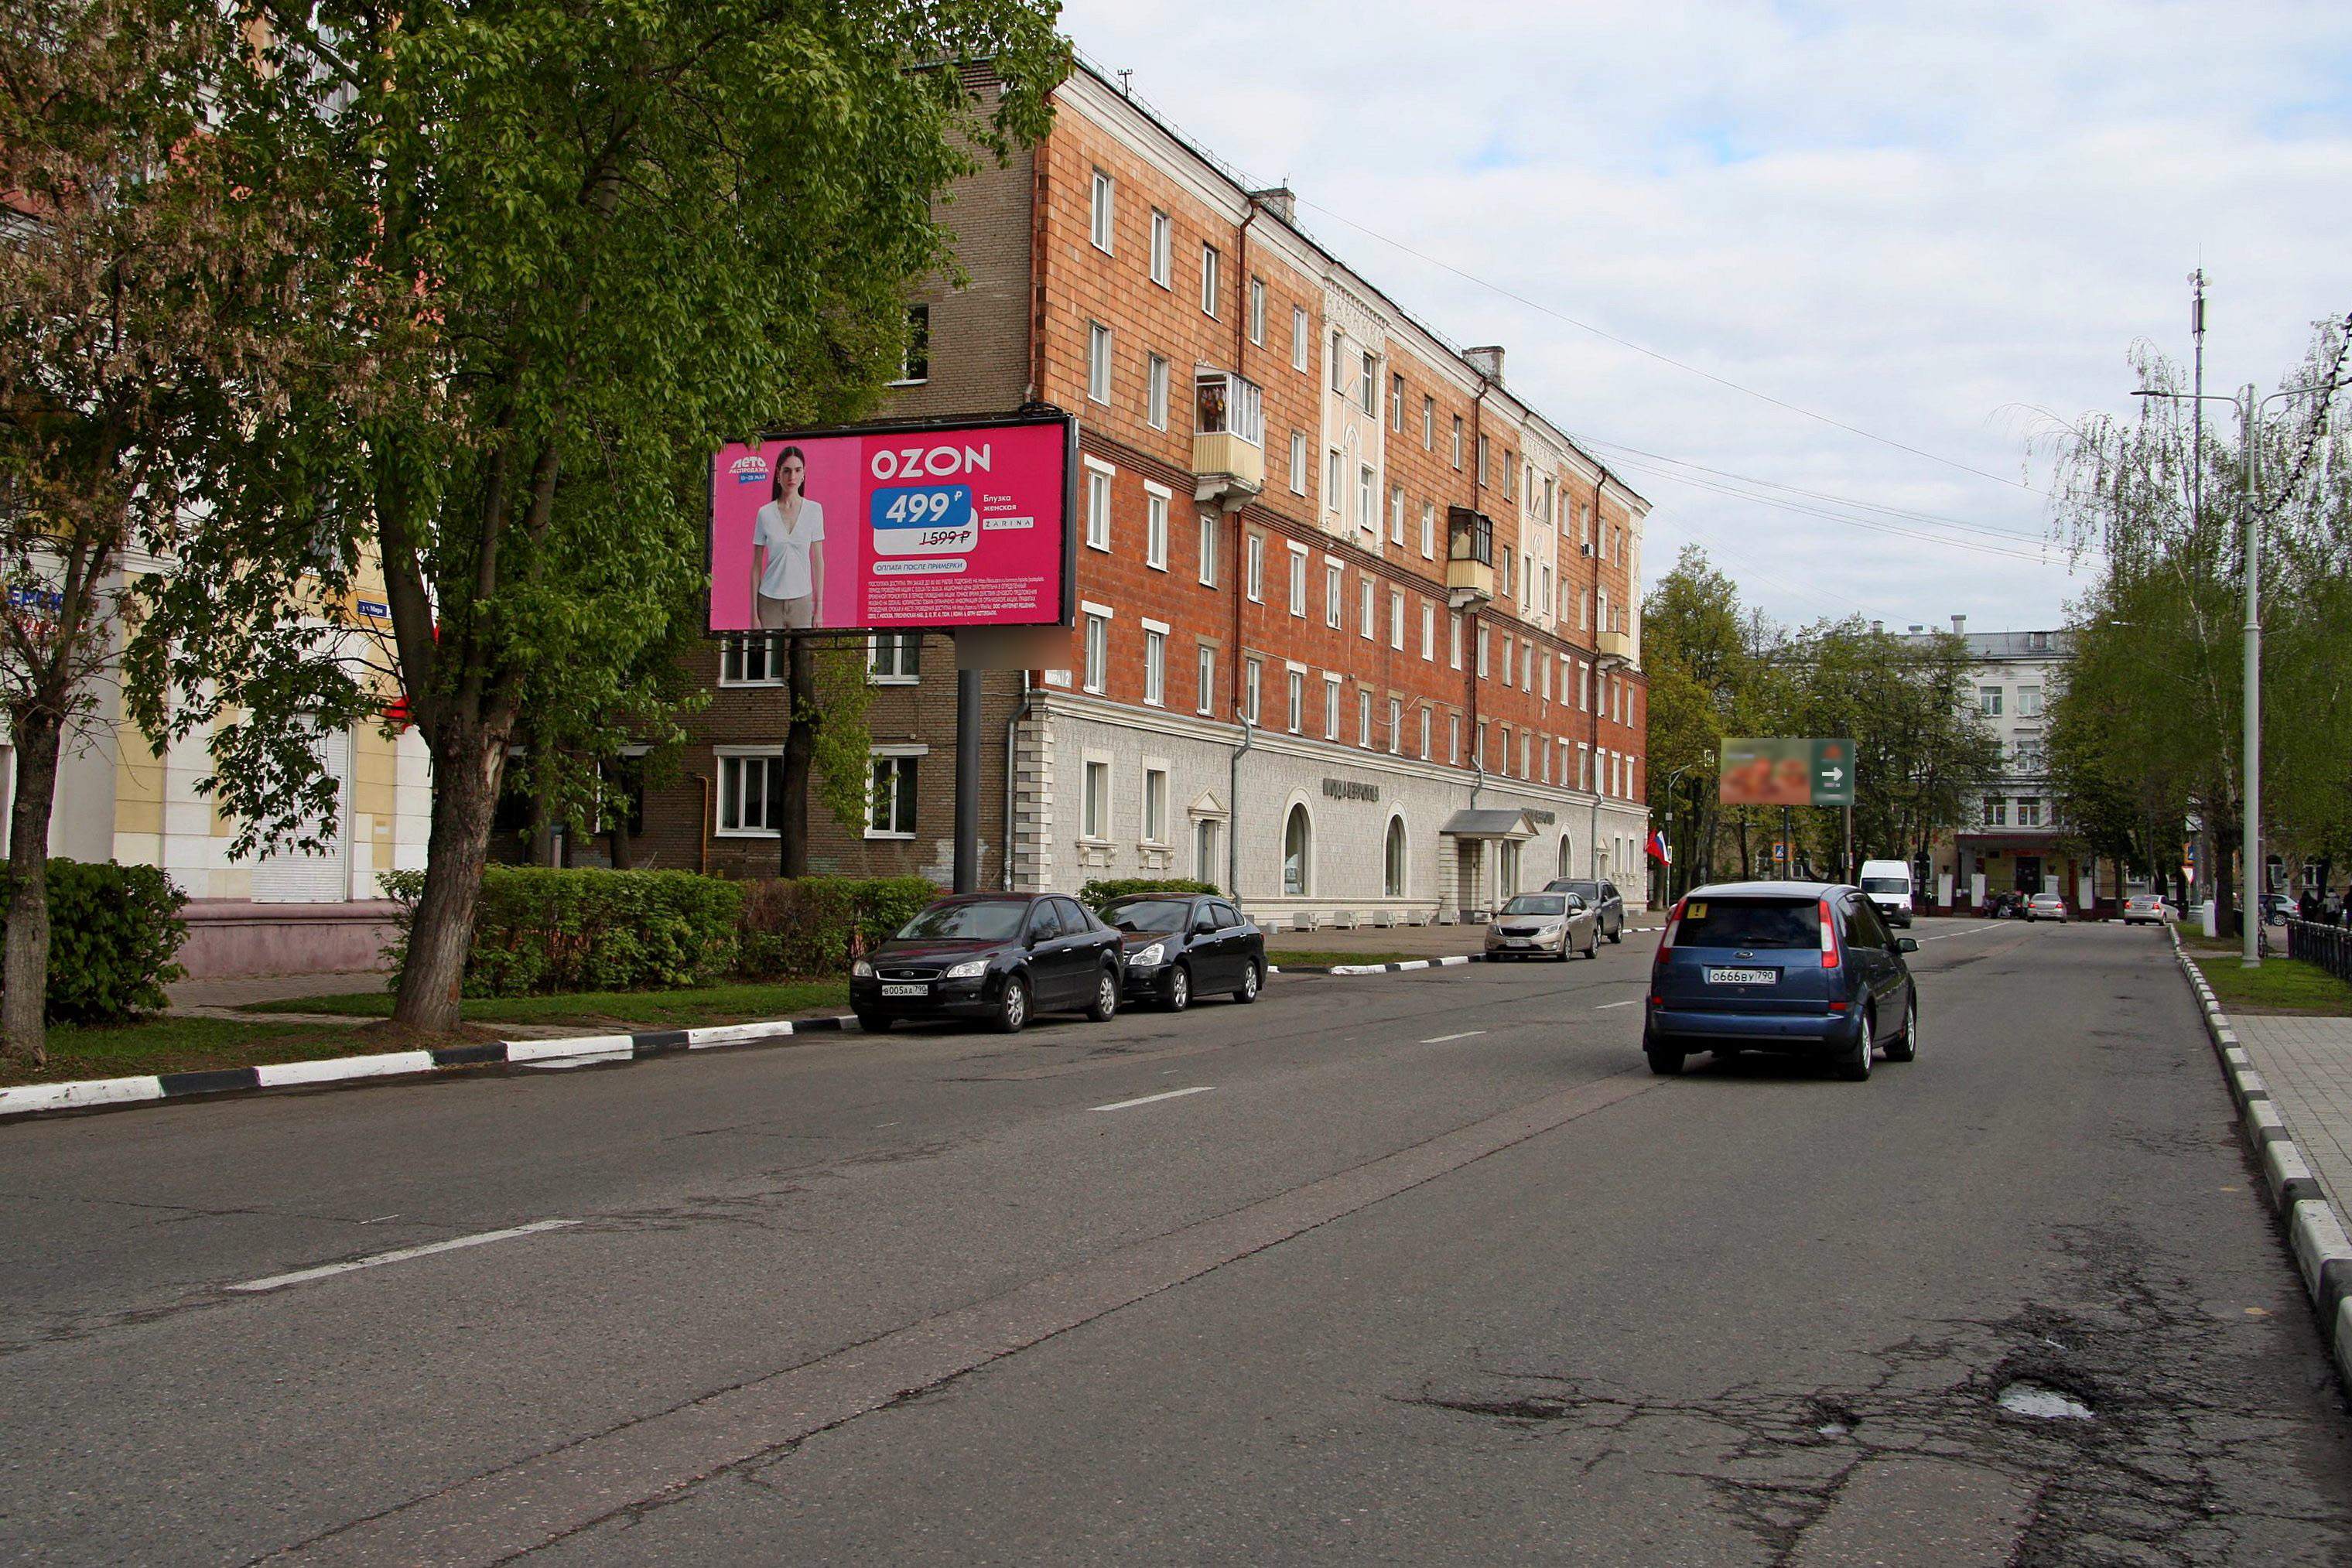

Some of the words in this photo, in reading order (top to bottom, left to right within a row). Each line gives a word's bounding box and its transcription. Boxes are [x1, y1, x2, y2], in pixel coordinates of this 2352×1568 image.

[871, 443, 990, 480] OZON
[983, 494, 1011, 504] Блузка
[886, 492, 949, 523] 499
[986, 519, 1031, 528] ZARINA
[927, 562, 963, 570] ПРИМЕРКИ
[1065, 672, 1070, 686] 2
